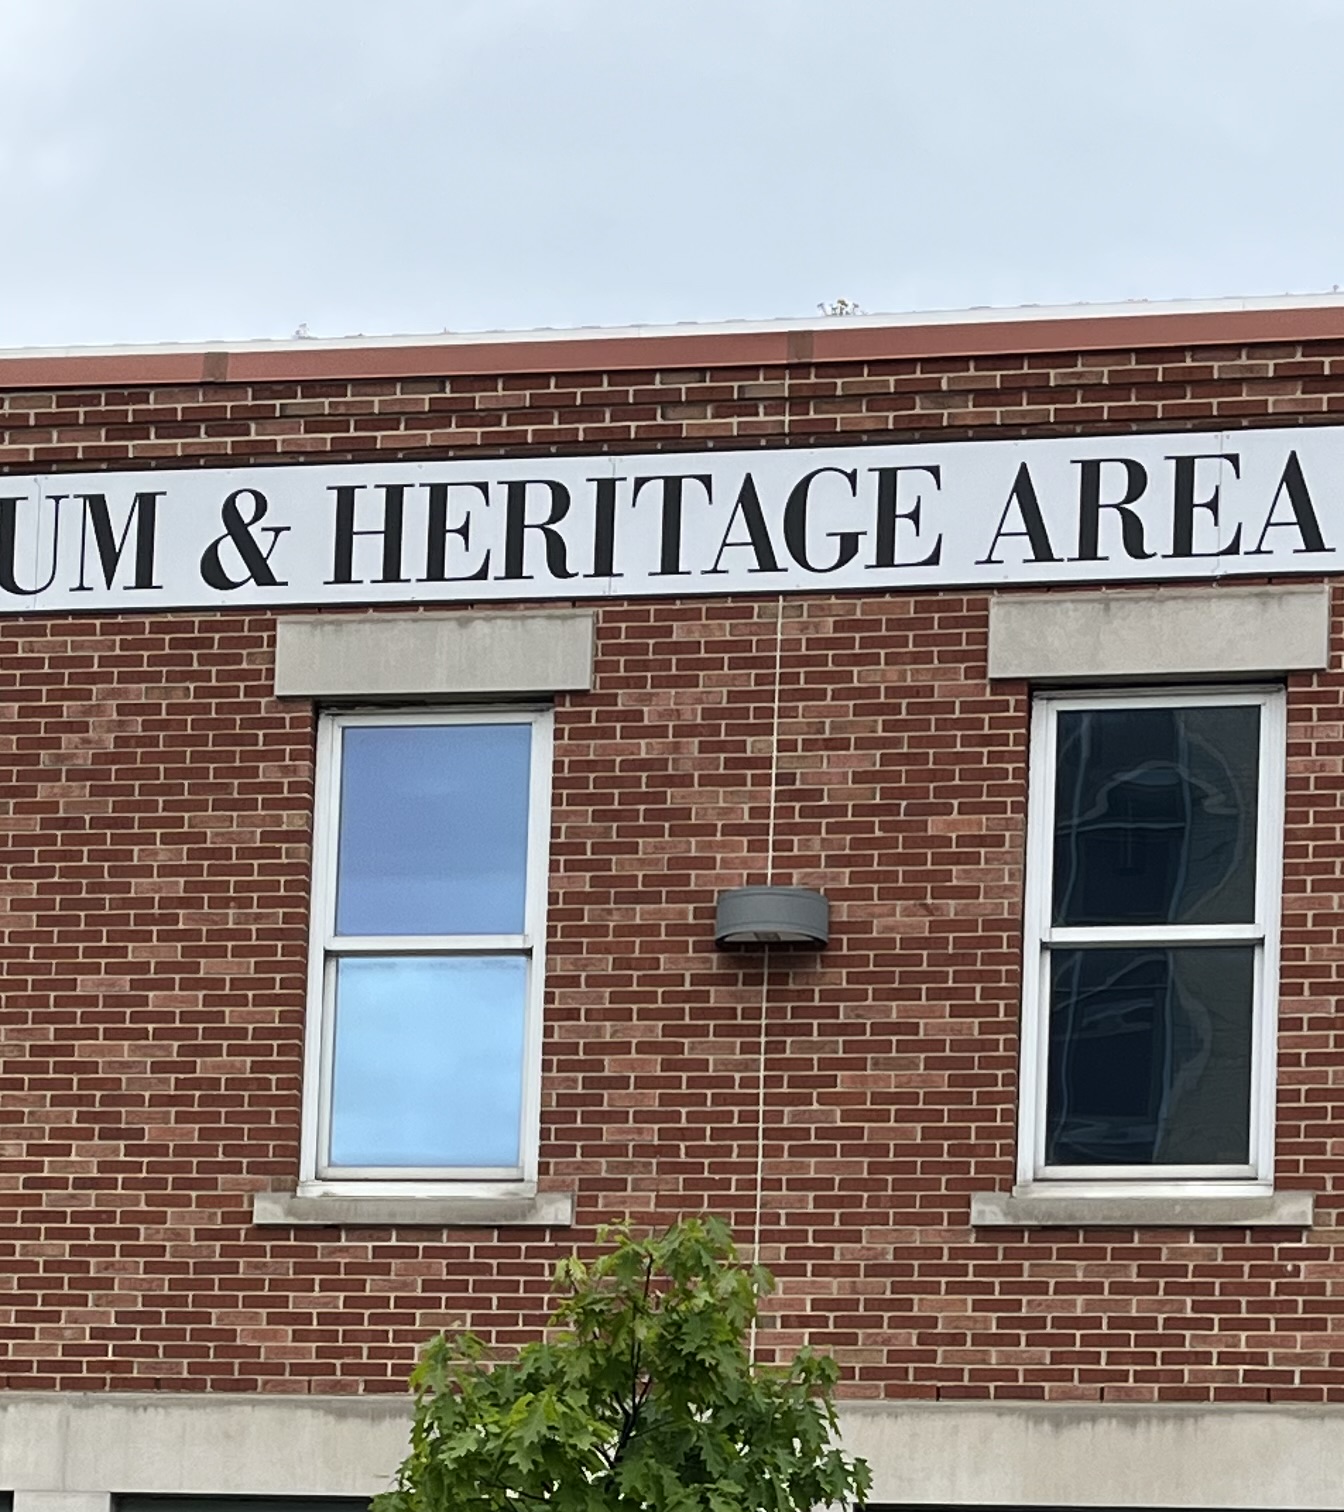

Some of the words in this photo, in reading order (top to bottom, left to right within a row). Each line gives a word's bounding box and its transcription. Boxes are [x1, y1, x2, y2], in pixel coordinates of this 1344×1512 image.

[201, 488, 291, 590] &
[323, 465, 942, 584] HERITAGE
[975, 451, 1335, 565] AREA
